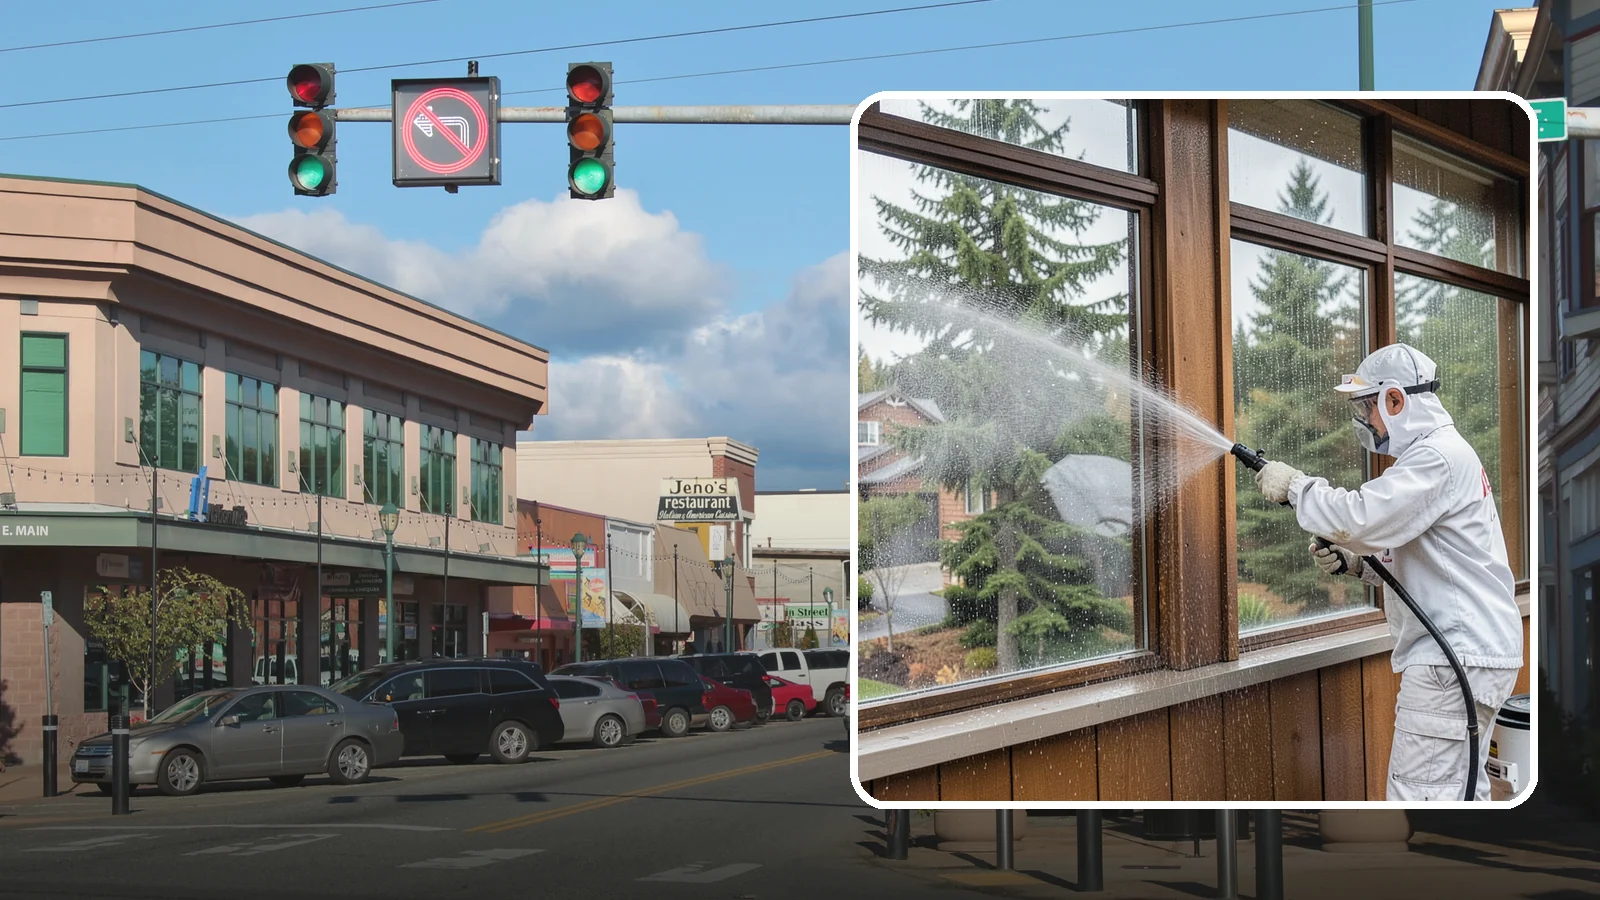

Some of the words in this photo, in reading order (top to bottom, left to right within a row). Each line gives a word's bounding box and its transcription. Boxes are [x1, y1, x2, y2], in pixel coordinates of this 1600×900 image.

[669, 479, 727, 495] Jeno's
[665, 496, 731, 509] restaurant
[658, 509, 681, 520] Italian
[685, 509, 715, 520] American
[714, 509, 738, 520] Cuisine
[2, 525, 13, 536] E.
[15, 525, 49, 536] MAIN
[797, 607, 828, 617] Street
[791, 619, 824, 627] lass
